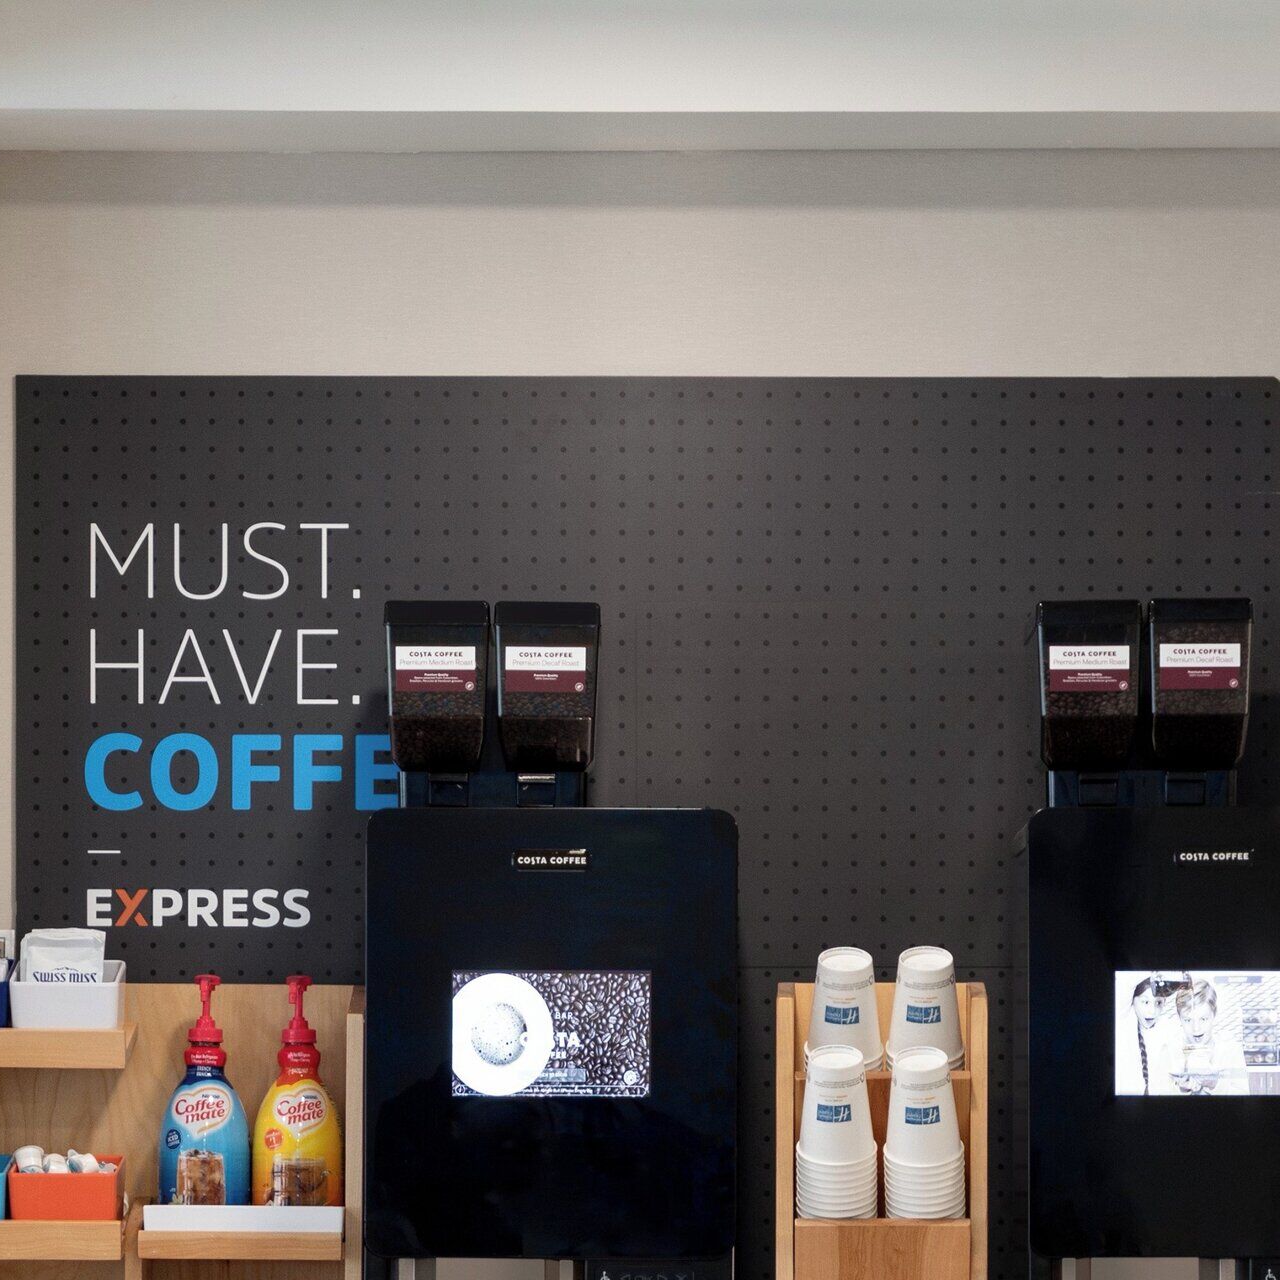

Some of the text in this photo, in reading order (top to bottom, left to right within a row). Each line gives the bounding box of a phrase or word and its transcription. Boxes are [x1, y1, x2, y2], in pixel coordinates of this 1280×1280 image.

[90, 522, 361, 600] MUST.
[90, 629, 360, 704] HAVE.
[84, 732, 402, 811] COFFE
[517, 856, 587, 865] COSTA COFFEE
[1180, 852, 1249, 861] COSTA COFFEE
[86, 888, 311, 928] EXPRESS
[175, 1098, 225, 1116] Coffee
[276, 1100, 322, 1117] Coffee
[186, 1108, 225, 1124] mate
[288, 1109, 324, 1125] mate
